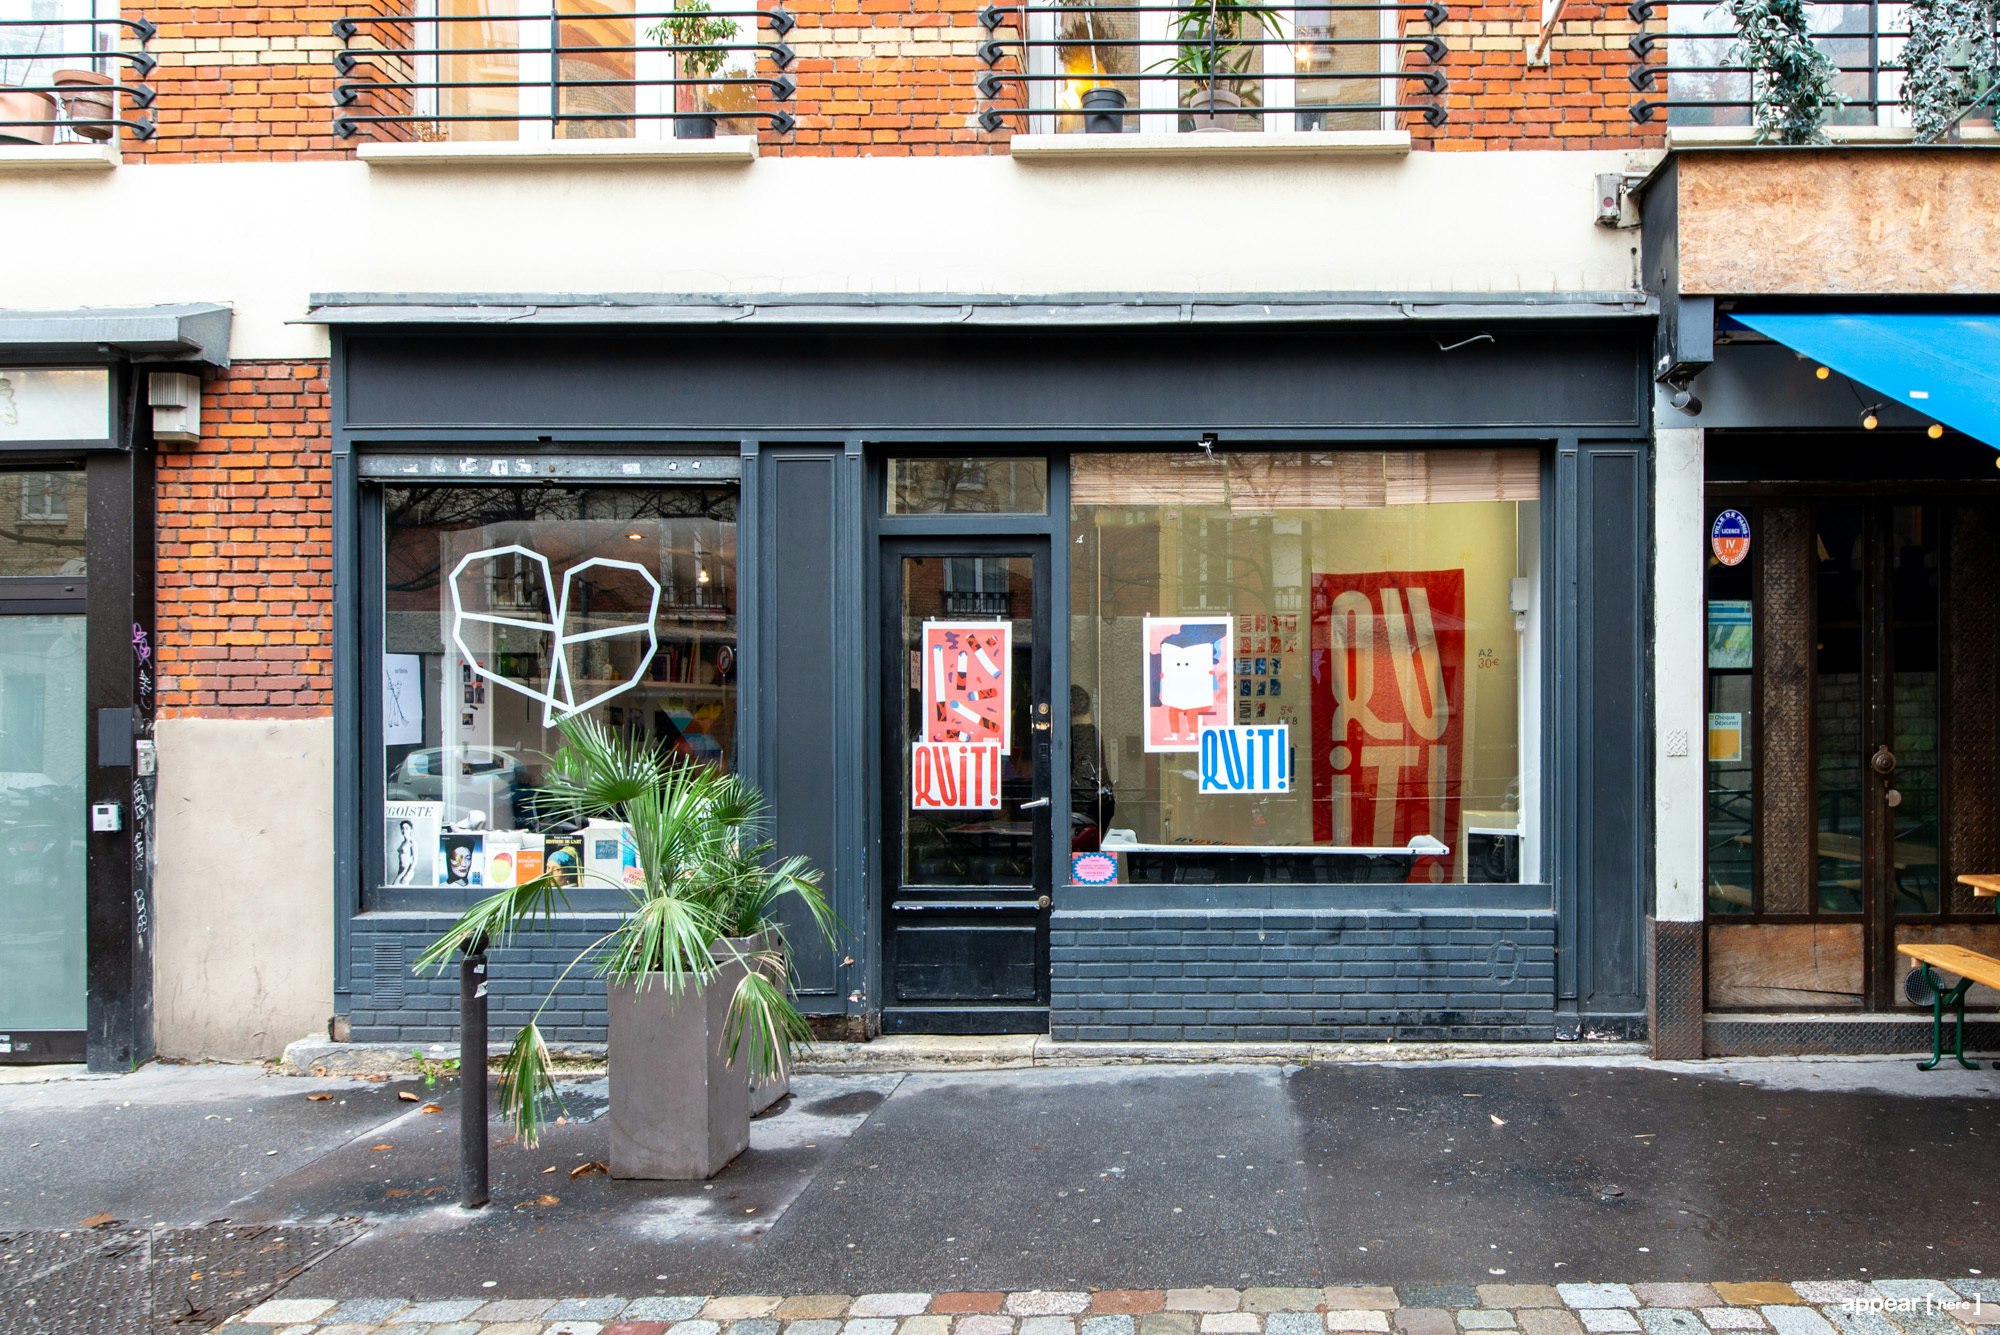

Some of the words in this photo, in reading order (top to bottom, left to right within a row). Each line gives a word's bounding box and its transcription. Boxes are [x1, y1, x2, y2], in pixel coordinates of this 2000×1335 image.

[1714, 517, 1725, 535] VILLE
[1736, 516, 1748, 535] PARIS
[1726, 539, 1736, 549] IV
[1478, 657, 1500, 669] 30€
[1202, 729, 1286, 790] QUiT!
[915, 746, 999, 807] QUiT!
[386, 806, 434, 817] GOISTE
